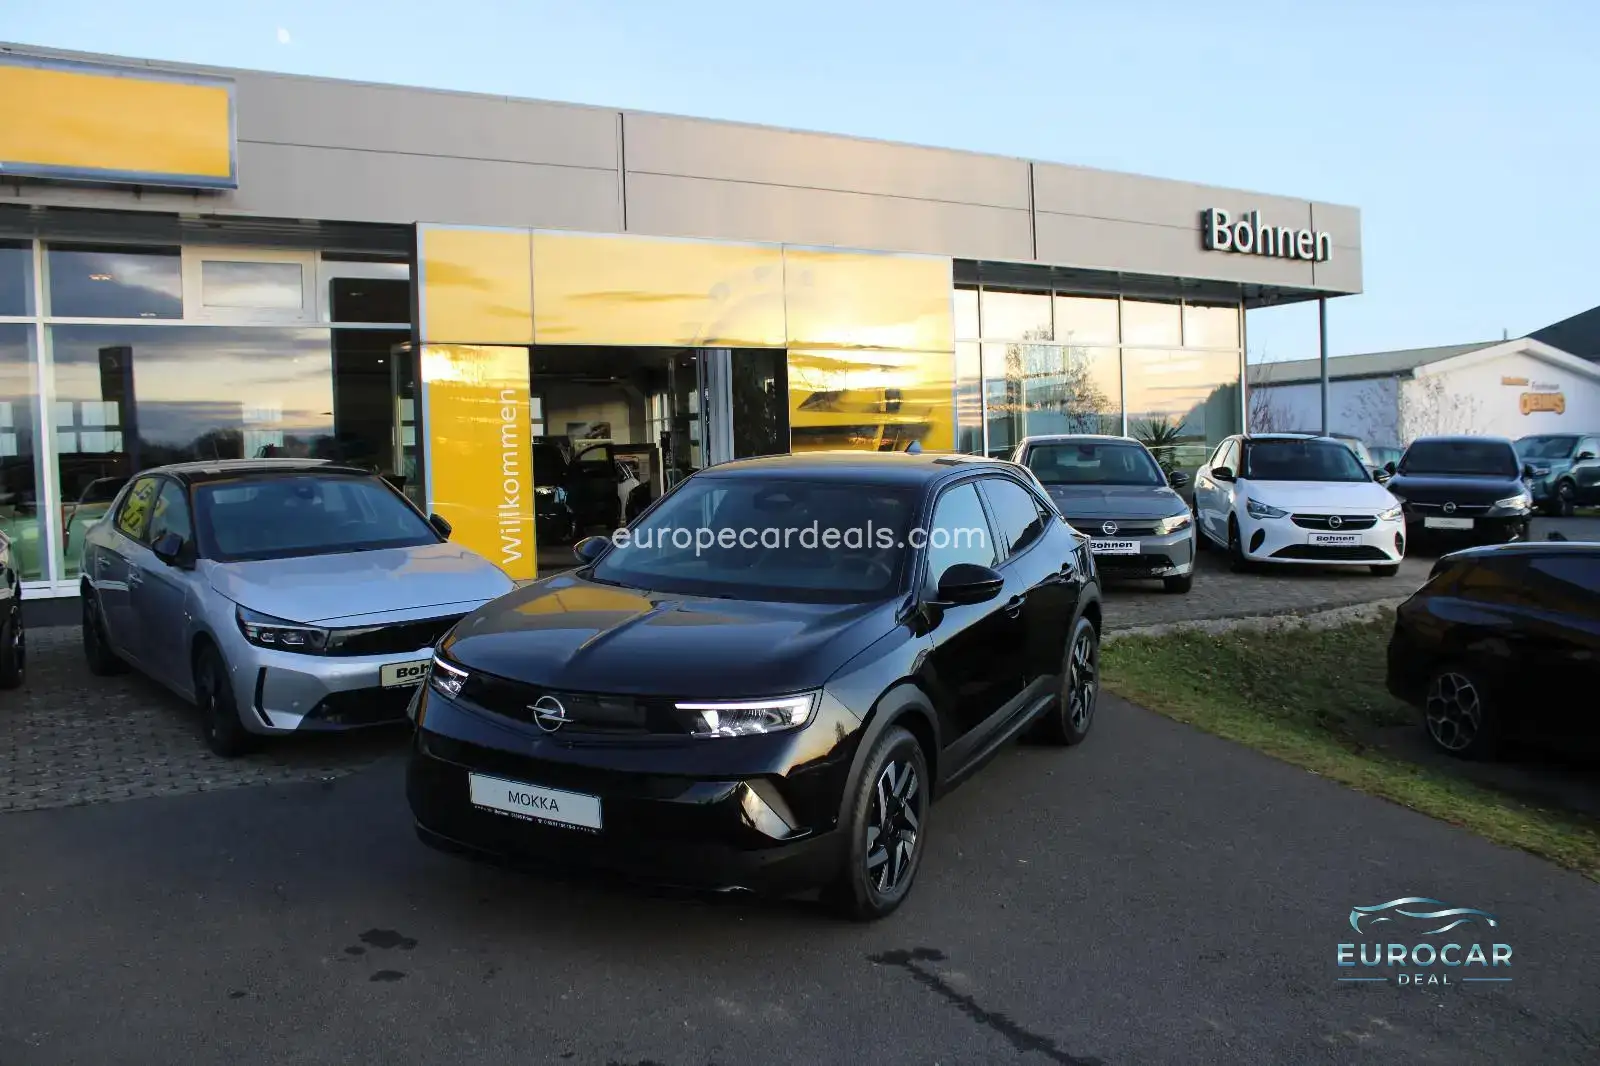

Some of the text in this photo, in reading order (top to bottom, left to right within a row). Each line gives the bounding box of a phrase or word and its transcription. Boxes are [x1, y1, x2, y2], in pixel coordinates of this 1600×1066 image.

[1206, 206, 1333, 262] Bohnen
[497, 389, 523, 564] Willkommen
[396, 663, 430, 679] Boh
[508, 790, 560, 812] MOKKA
